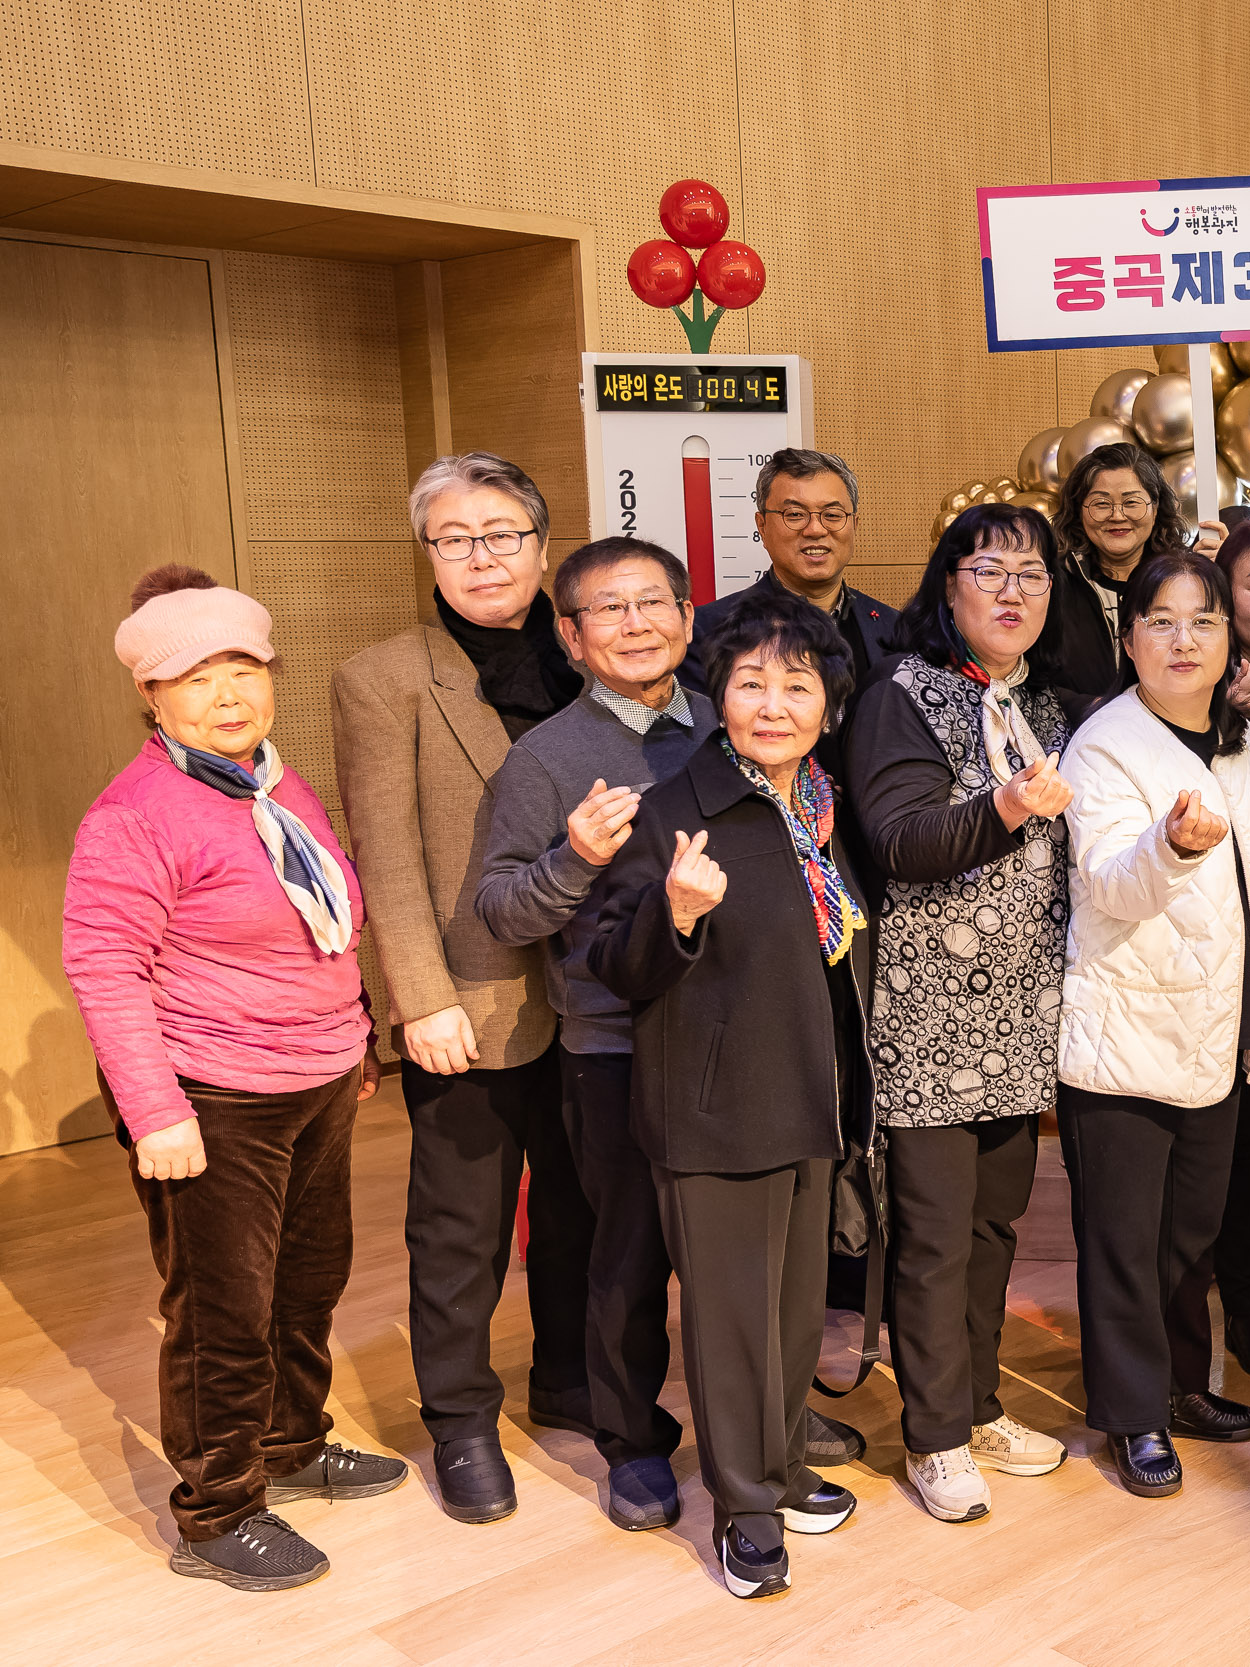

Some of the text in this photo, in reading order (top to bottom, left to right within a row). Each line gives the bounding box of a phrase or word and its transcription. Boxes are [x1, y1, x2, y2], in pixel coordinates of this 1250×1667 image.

[1211, 204, 1237, 216] 발전하는
[1185, 215, 1238, 235] 행복광진
[603, 373, 648, 402] 사랑의
[653, 373, 684, 401] 온도
[618, 469, 637, 538] 202
